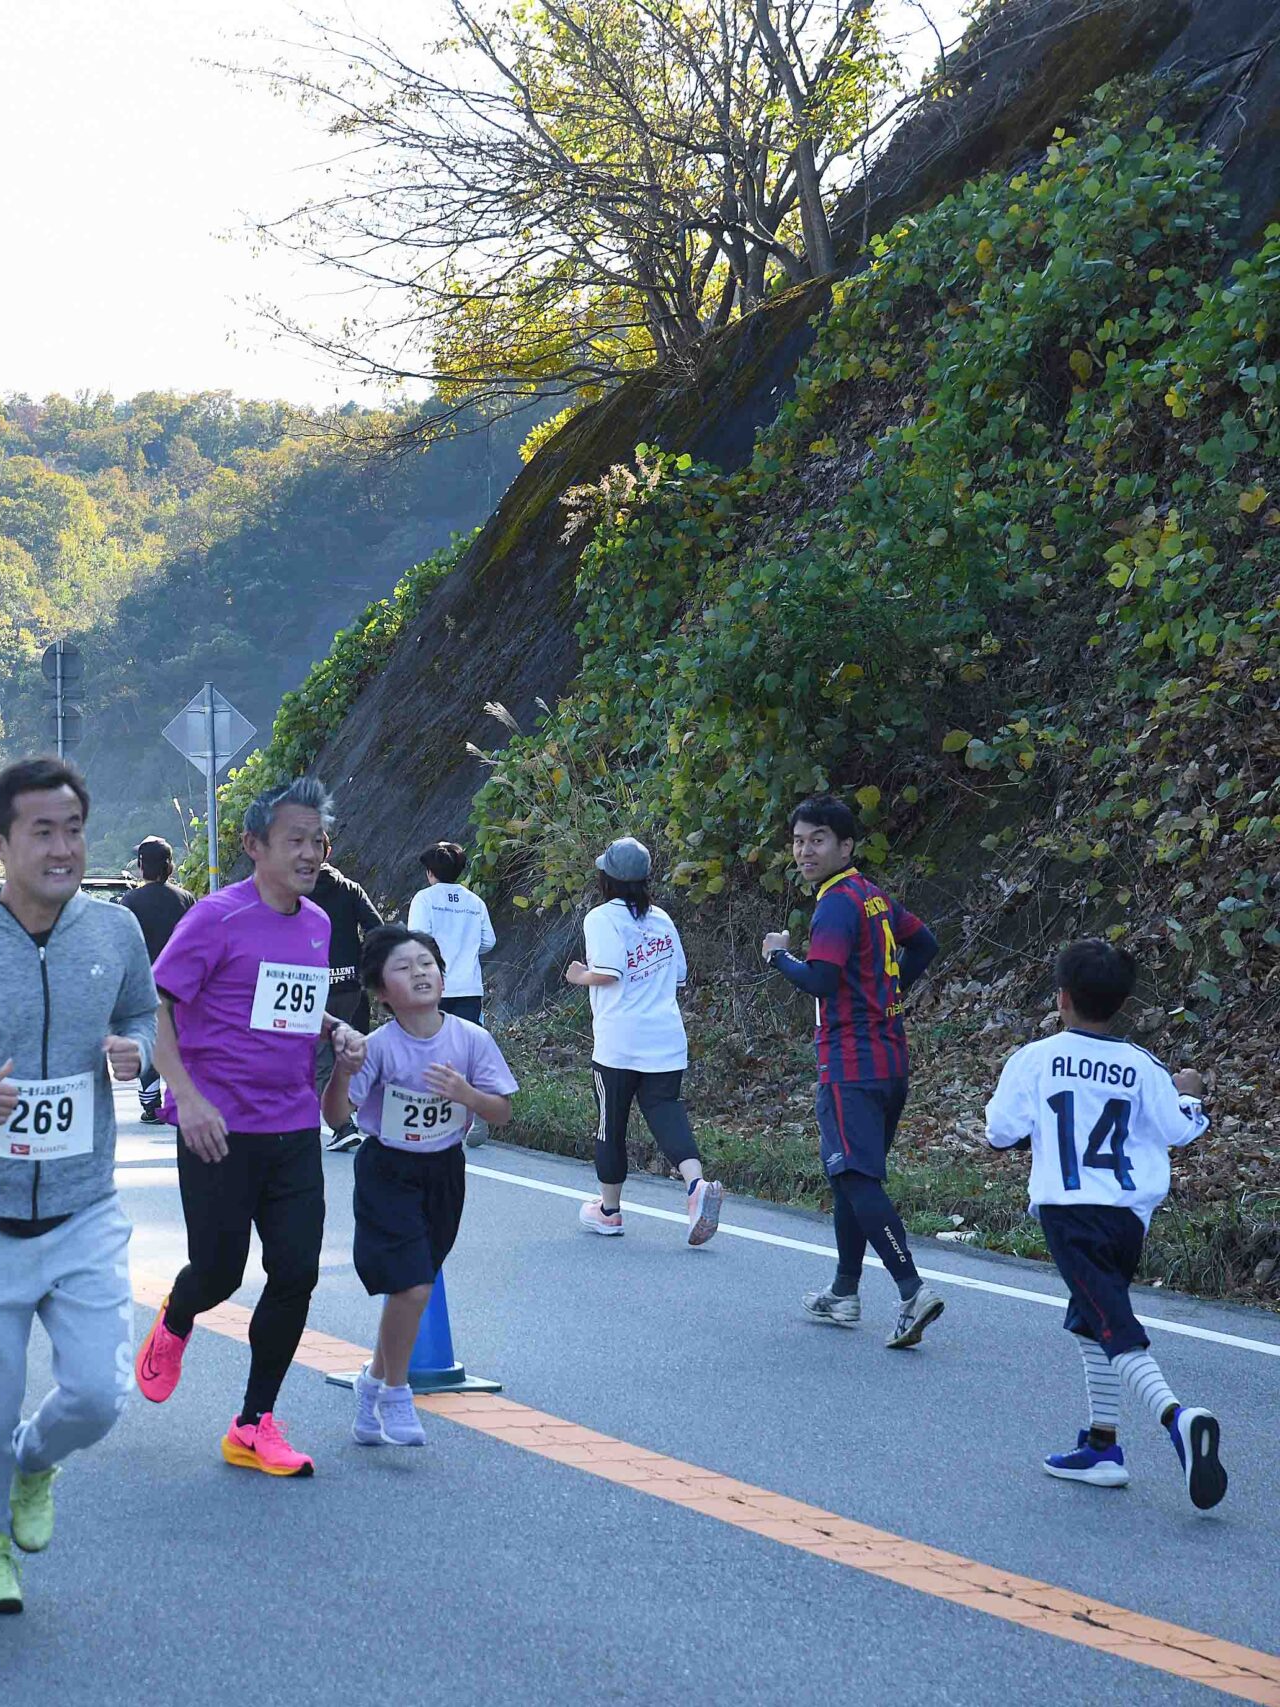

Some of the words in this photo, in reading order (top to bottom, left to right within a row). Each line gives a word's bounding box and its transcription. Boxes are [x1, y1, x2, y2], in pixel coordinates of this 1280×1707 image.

[273, 982, 317, 1013] 295
[1052, 1056, 1137, 1088] ALONSO
[8, 1096, 74, 1135] 269
[403, 1100, 452, 1128] 295
[1046, 1090, 1137, 1191] 14
